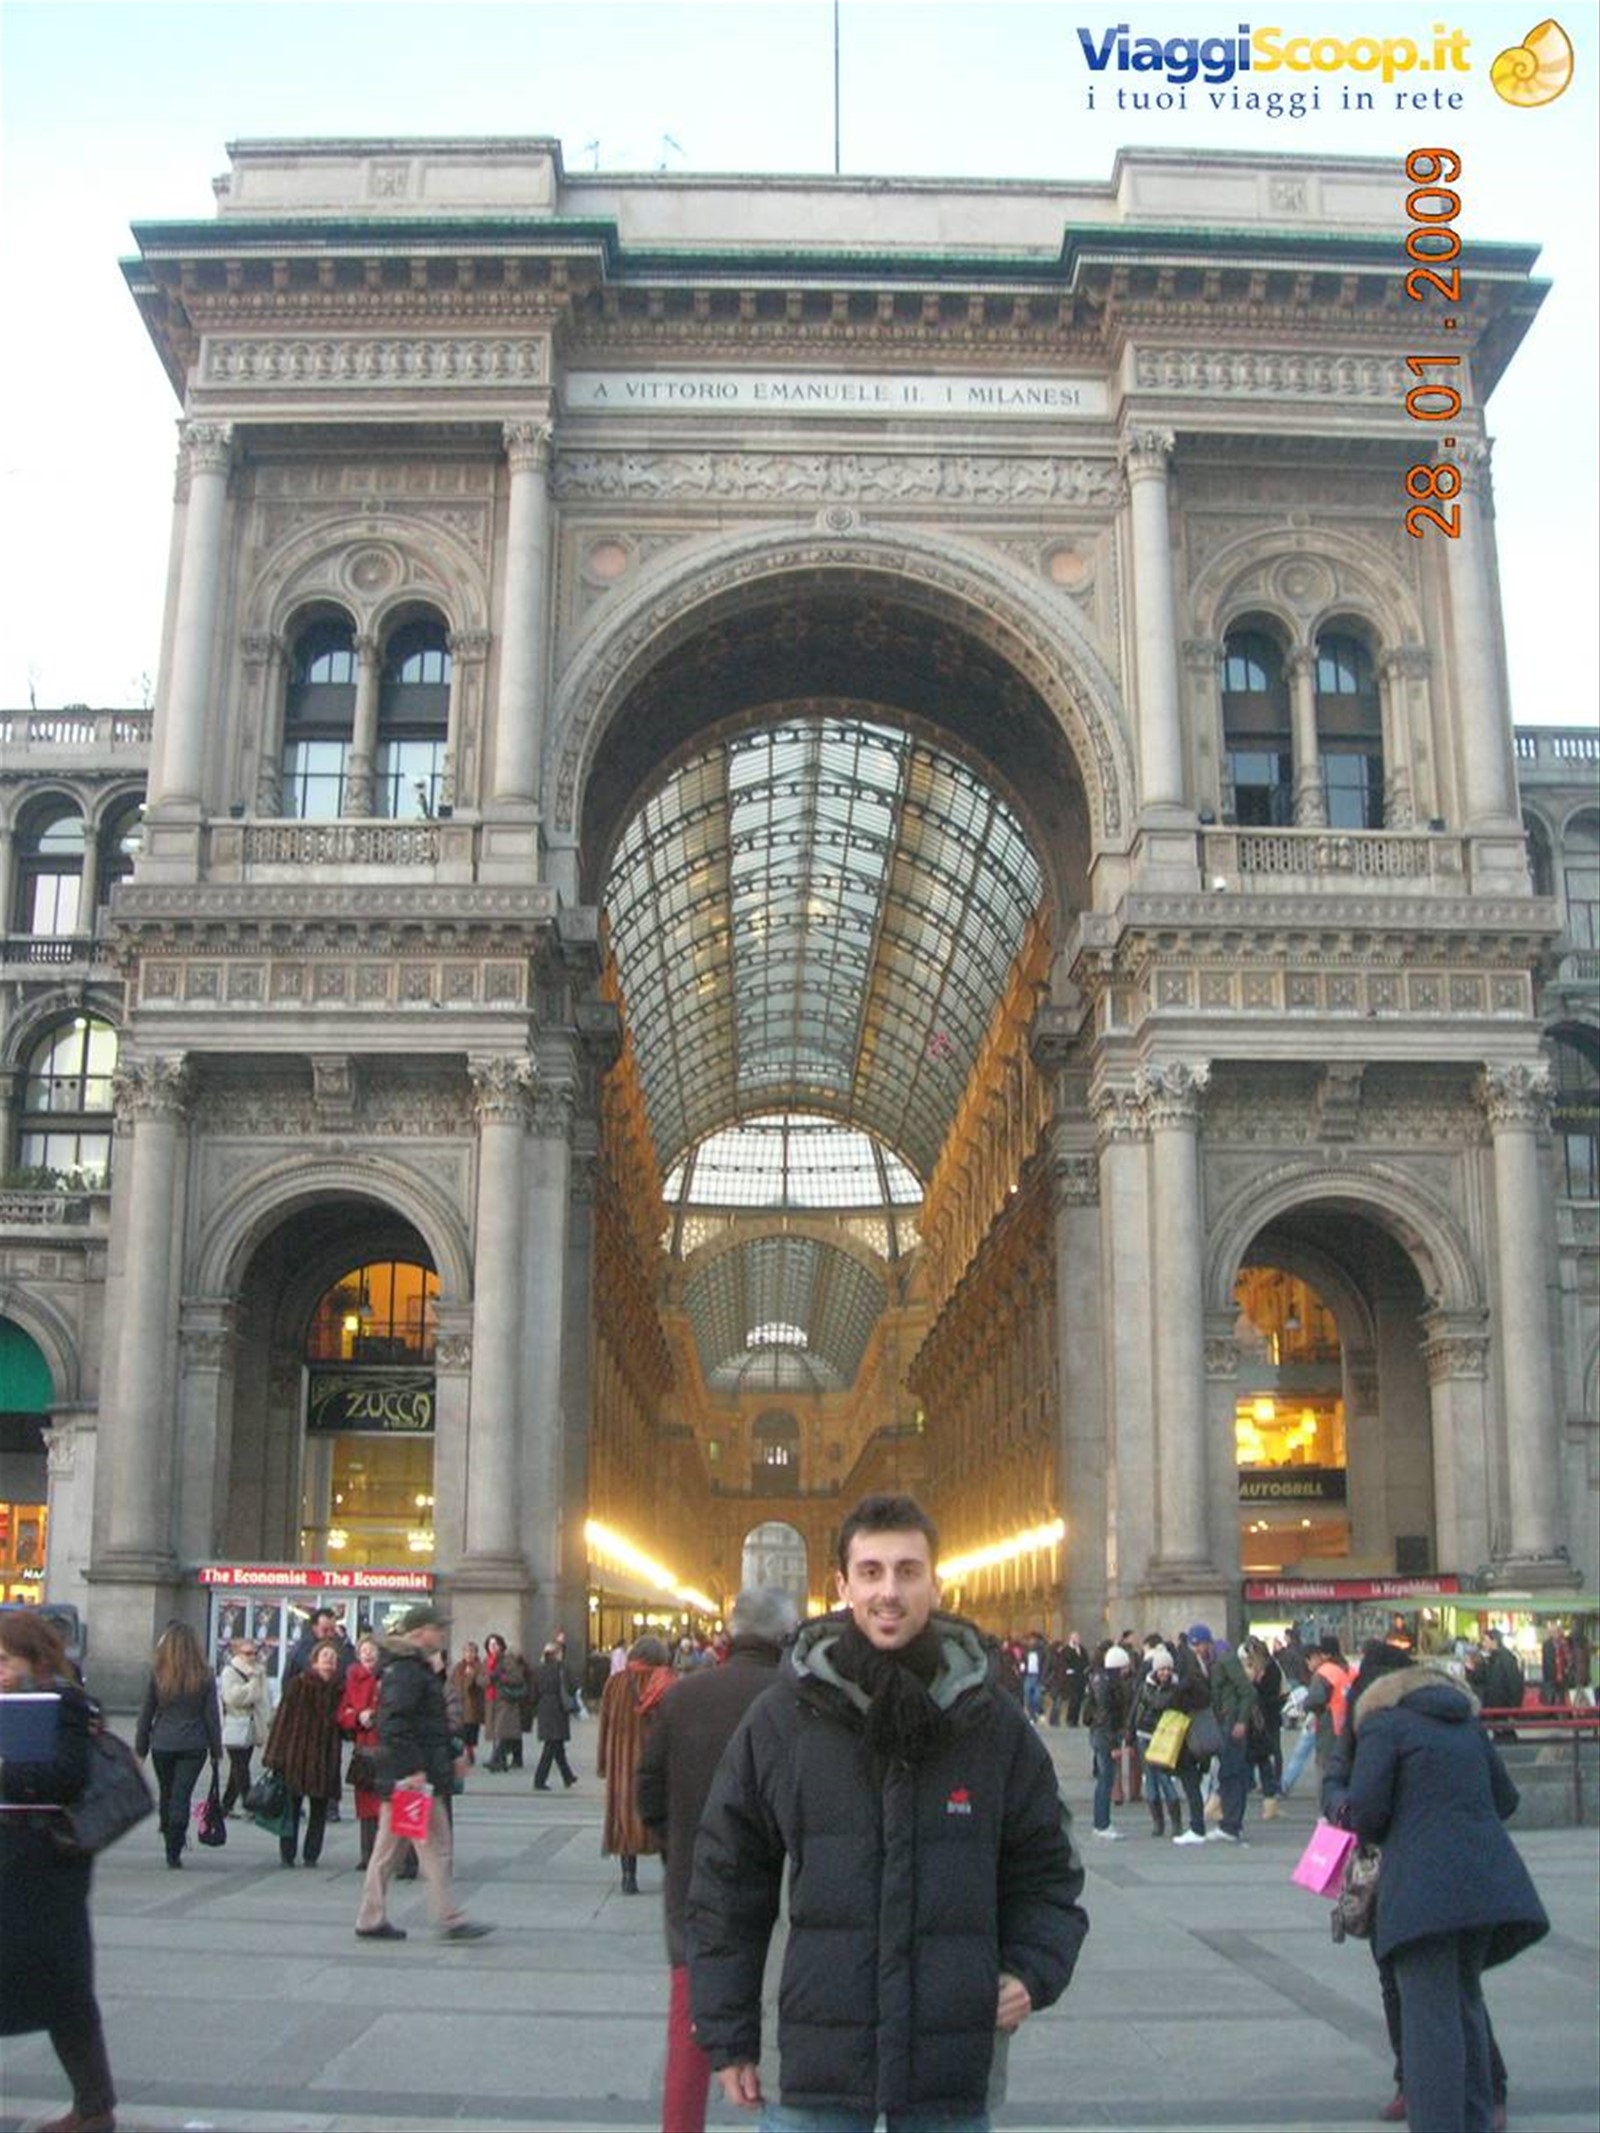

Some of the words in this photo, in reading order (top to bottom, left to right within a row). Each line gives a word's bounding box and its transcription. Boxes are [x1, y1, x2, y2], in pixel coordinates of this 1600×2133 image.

[593, 382, 609, 399] A
[626, 382, 738, 400] VITTORIO
[754, 382, 887, 401] EMANUELE
[945, 386, 952, 404] I
[968, 387, 1080, 405] MILANESI
[203, 1569, 229, 1583] The
[233, 1570, 307, 1585] Economist
[322, 1572, 350, 1586] The
[354, 1572, 428, 1588] Economist
